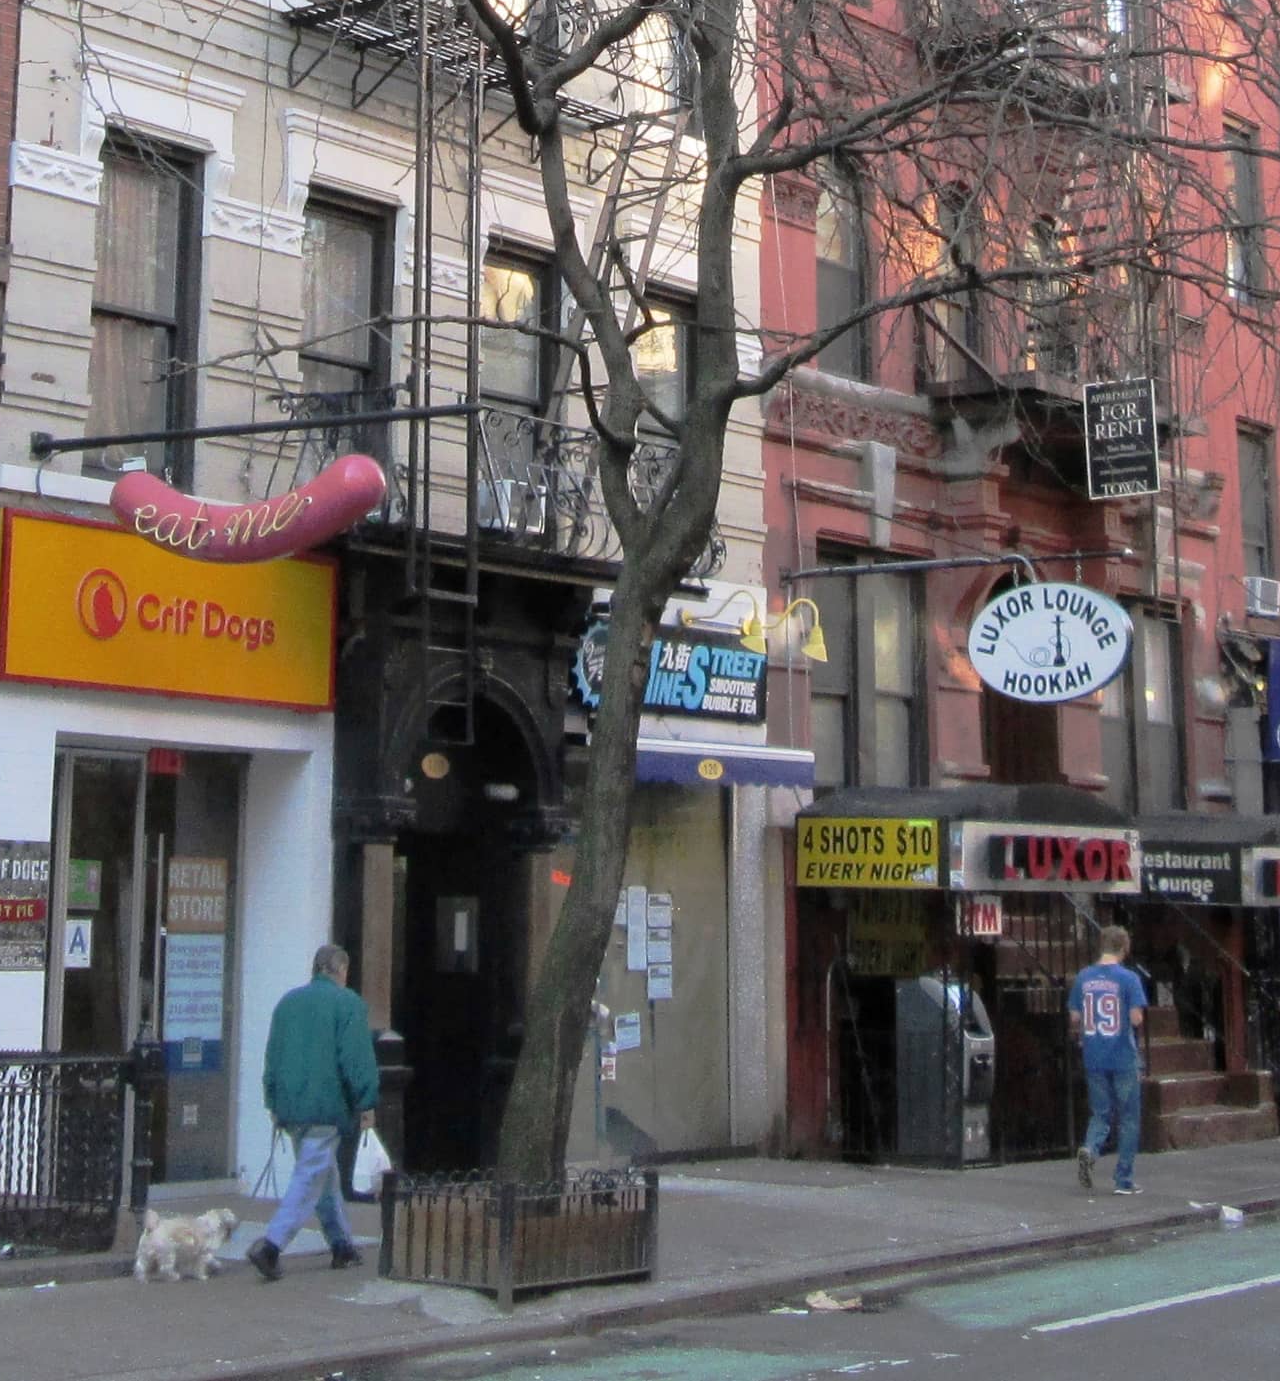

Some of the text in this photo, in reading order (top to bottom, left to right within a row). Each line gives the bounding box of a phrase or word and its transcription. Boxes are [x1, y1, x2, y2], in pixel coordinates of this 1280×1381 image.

[1100, 402, 1140, 421] FOR
[1094, 418, 1147, 440] RENT
[1100, 480, 1148, 496] TOWN
[133, 492, 312, 550] eat me
[136, 593, 276, 652] Crif Dogs
[976, 587, 1118, 656] LUXOR LOUNGE
[707, 678, 758, 698] SMOOTHIE
[1002, 661, 1093, 697] HOOKAH
[701, 694, 758, 715] BUBBLE TEA
[803, 824, 933, 857] 4 SHOTS $10
[11, 858, 49, 882] DOGS
[1001, 833, 1133, 882] LUXOR
[1142, 850, 1231, 871] estaurant
[169, 860, 225, 889] RETAIL
[805, 862, 865, 882] EVERY
[1148, 872, 1215, 896] Lounge
[169, 893, 224, 921] STORE
[69, 925, 86, 955] A
[1083, 992, 1120, 1036] 19
